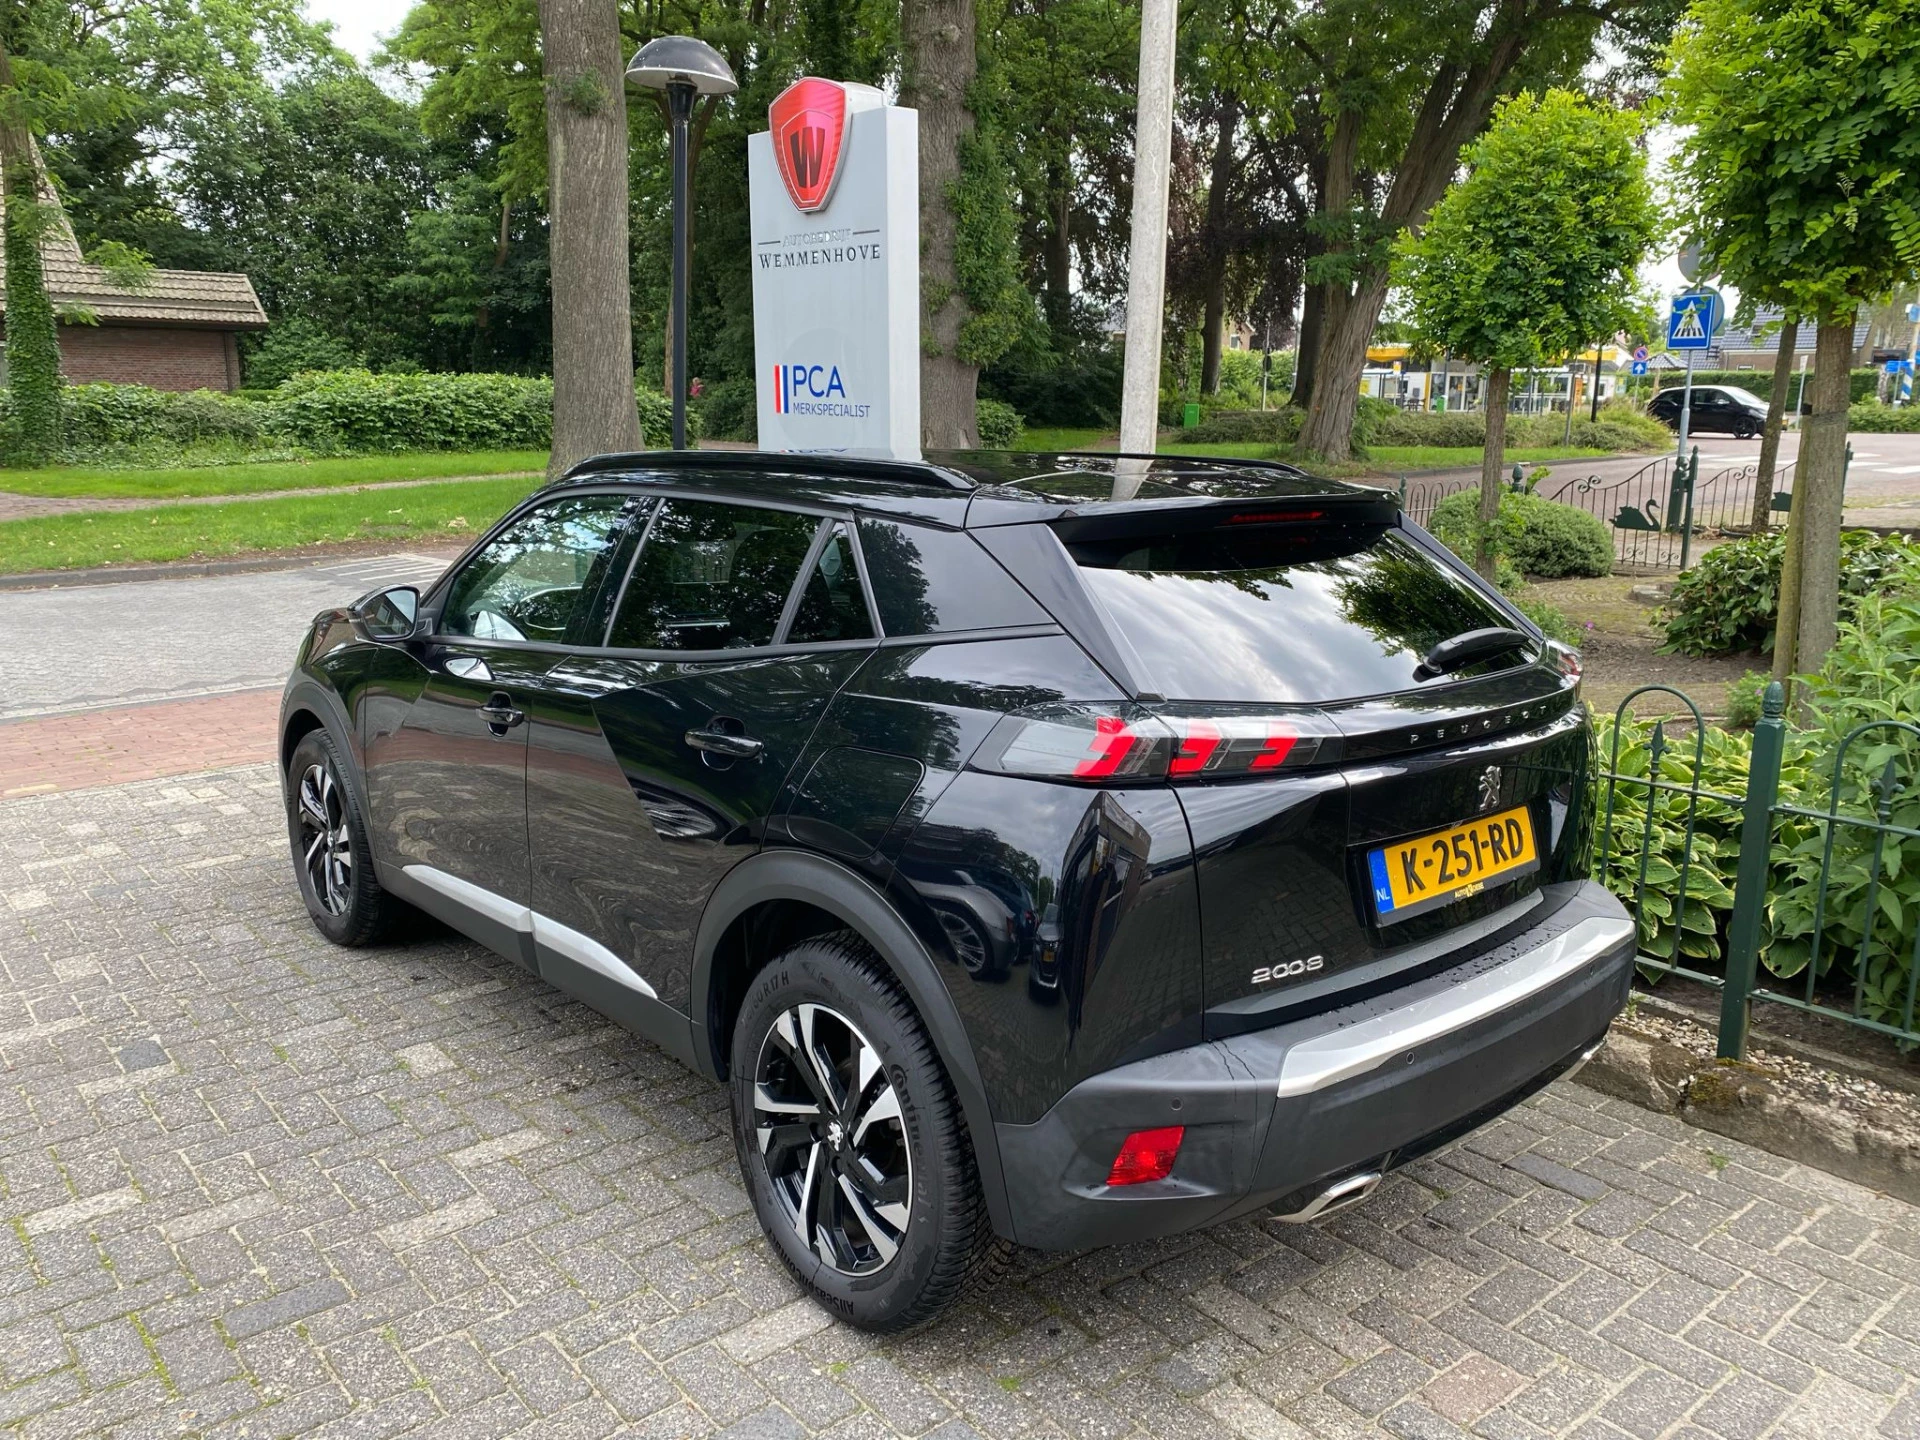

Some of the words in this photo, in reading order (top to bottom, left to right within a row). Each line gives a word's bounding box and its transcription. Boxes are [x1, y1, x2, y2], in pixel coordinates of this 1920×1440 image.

[790, 126, 826, 188] W
[782, 228, 851, 247] AUTOBEDRIJF
[758, 244, 880, 269] WEMMENHOVE
[792, 365, 846, 398] PCA
[793, 402, 870, 418] MERKSPECIALIST
[1410, 705, 1547, 745] PEUGEOT
[1401, 818, 1524, 895] K-251-RD
[1376, 888, 1391, 903] NL
[1251, 955, 1324, 984] 2008
